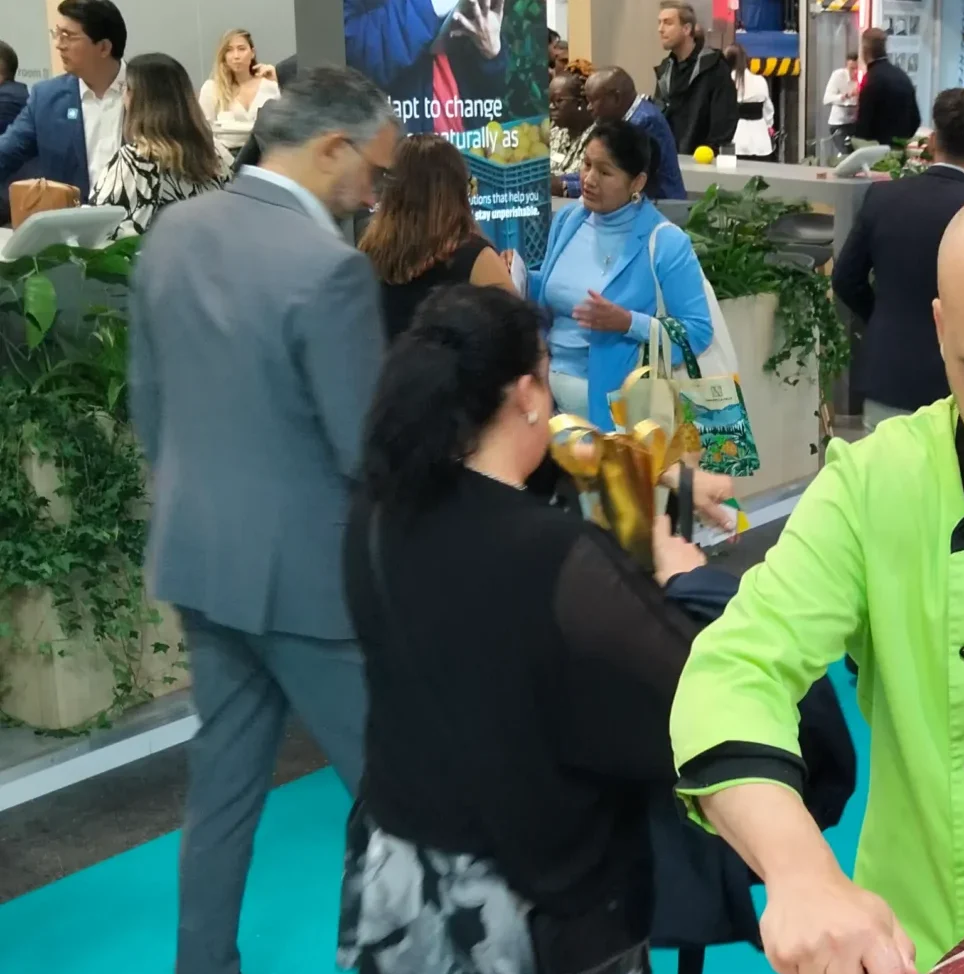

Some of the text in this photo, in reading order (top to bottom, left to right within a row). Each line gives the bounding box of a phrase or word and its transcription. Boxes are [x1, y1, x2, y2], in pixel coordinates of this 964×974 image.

[424, 97, 441, 118] to
[445, 95, 503, 121] change
[502, 129, 519, 148] as
[492, 191, 508, 204] that
[508, 190, 525, 204] help
[526, 191, 539, 204] you
[475, 209, 491, 221] stay
